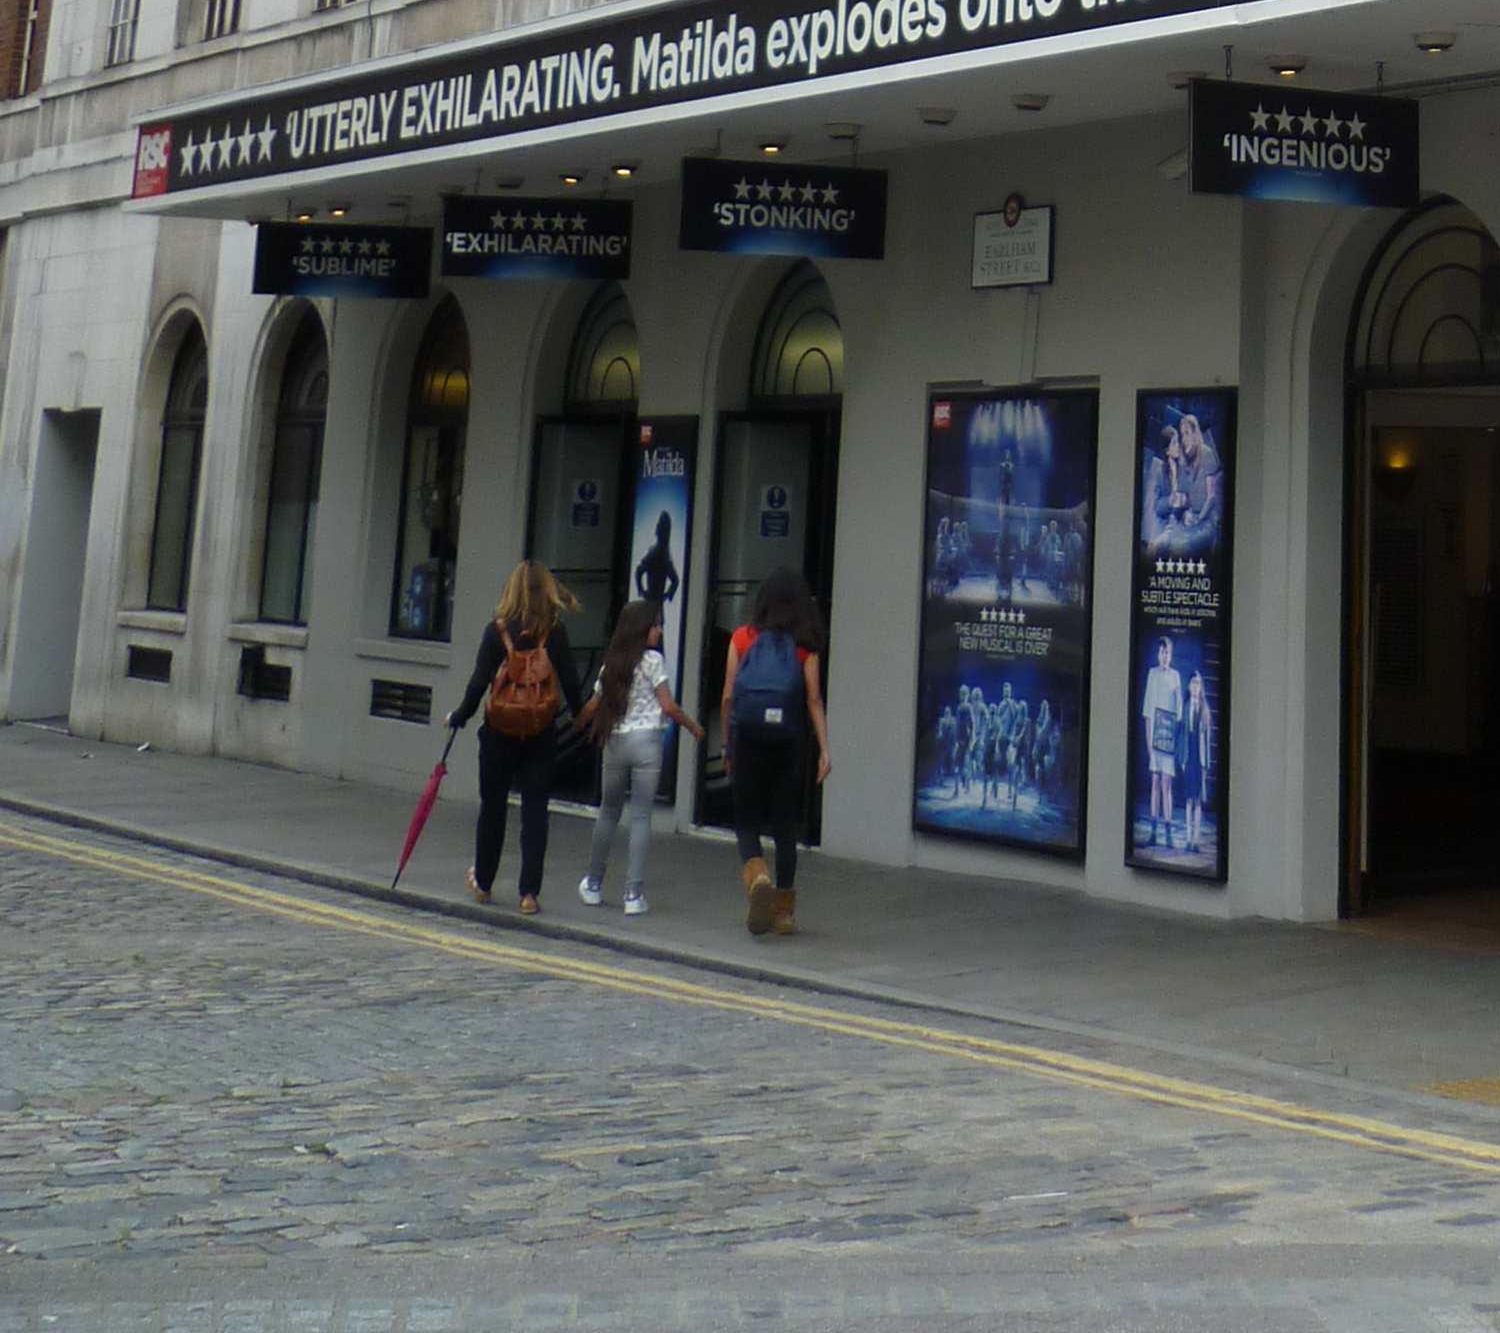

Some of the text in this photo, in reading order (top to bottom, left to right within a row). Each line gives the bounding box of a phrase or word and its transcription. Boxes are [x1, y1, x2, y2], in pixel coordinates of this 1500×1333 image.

[400, 44, 620, 138] EXHILARATING.
[630, 13, 757, 98] Matilda
[1157, 576, 1191, 590] MOVING
[1191, 577, 1211, 591] AND
[979, 637, 1015, 653] MUSICAL
